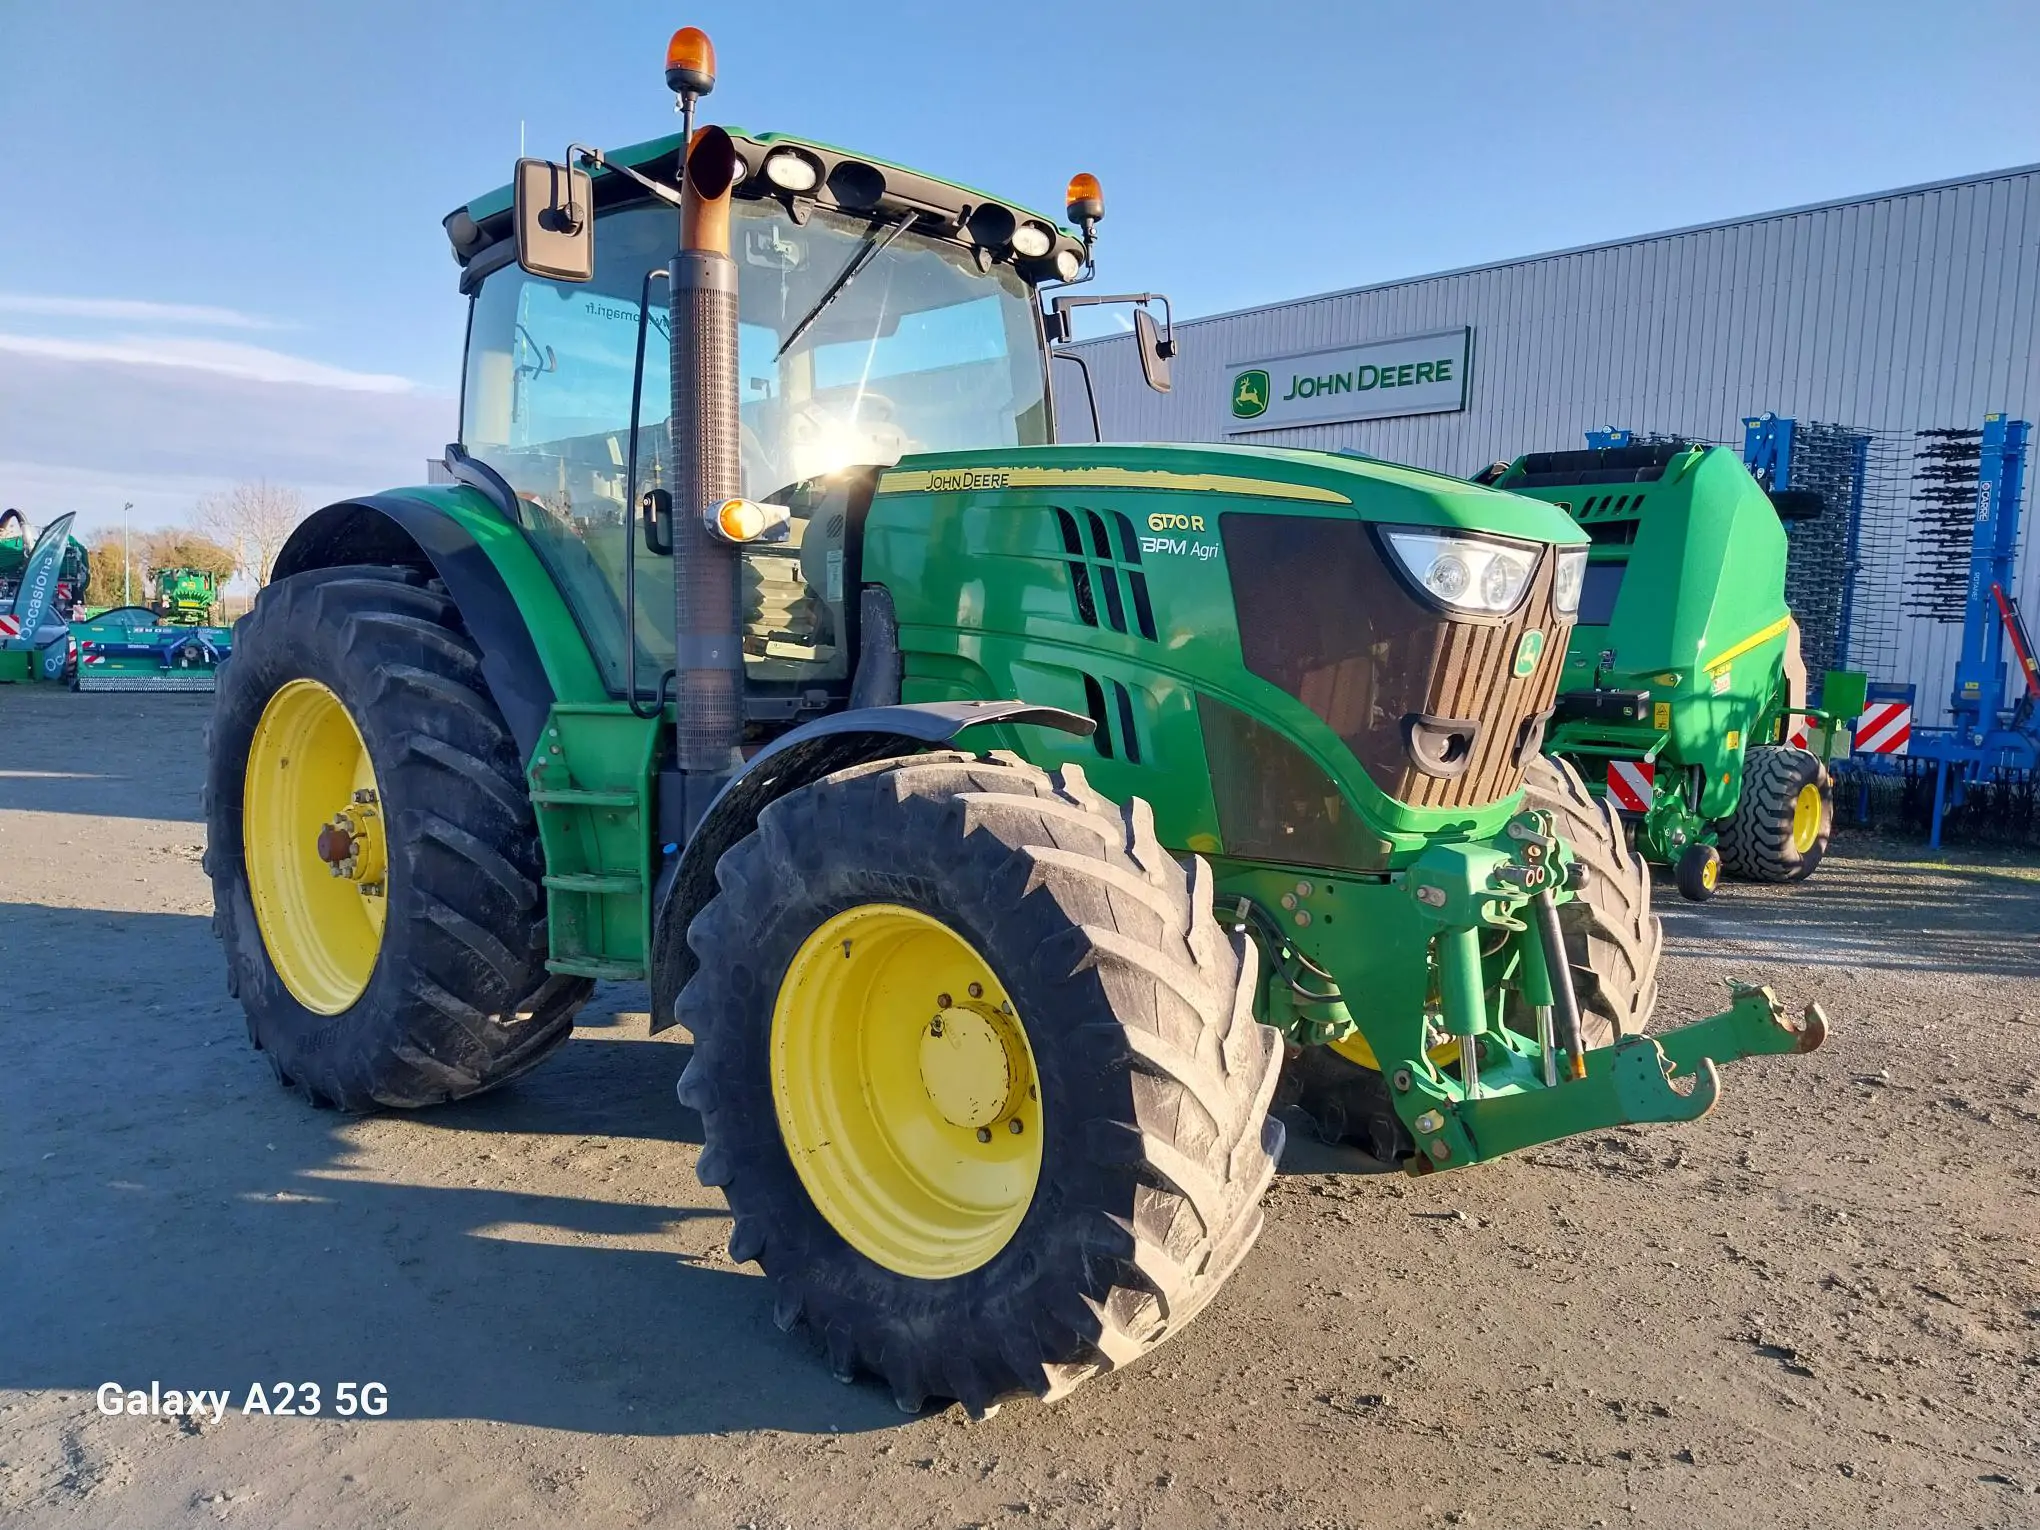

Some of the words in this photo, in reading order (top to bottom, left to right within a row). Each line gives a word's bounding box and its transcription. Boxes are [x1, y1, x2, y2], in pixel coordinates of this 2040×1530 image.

[1283, 372, 1353, 401] JOHN
[1357, 359, 1453, 391] DEERE
[926, 474, 961, 490] JOHN
[963, 472, 1010, 488] DEERE
[1190, 541, 1220, 561] Agri
